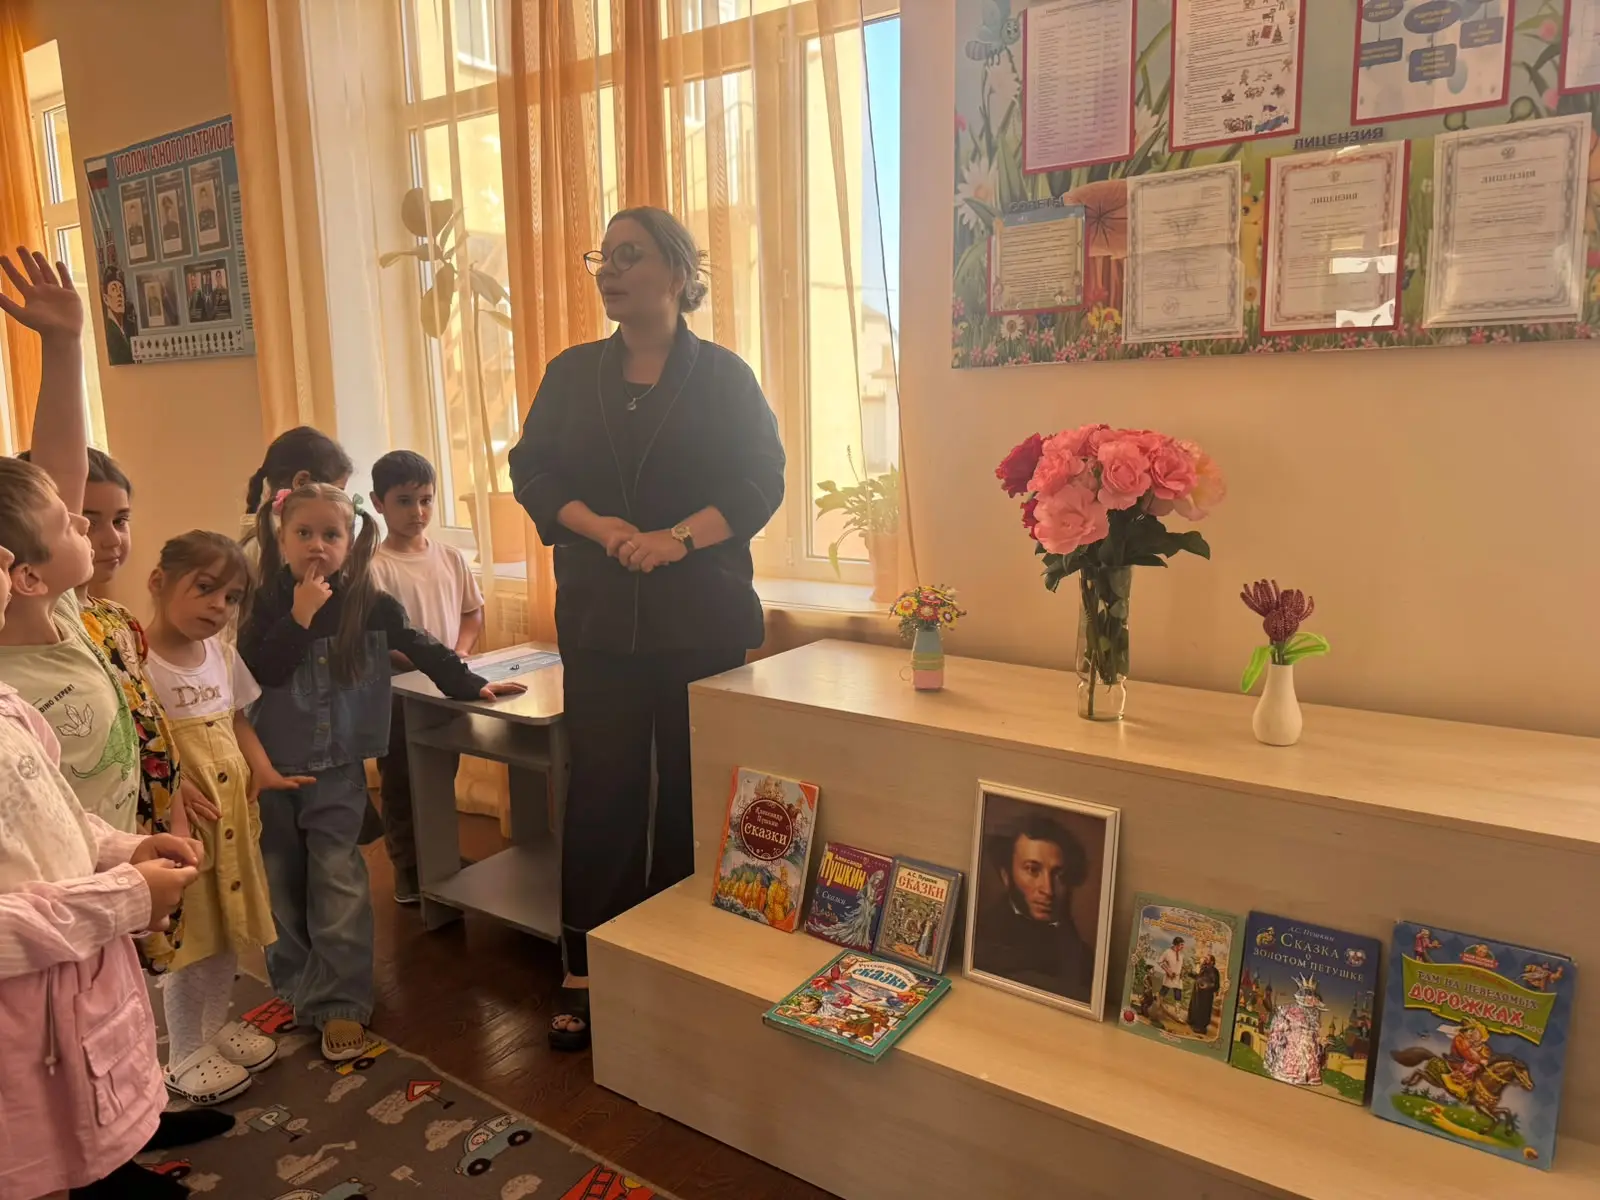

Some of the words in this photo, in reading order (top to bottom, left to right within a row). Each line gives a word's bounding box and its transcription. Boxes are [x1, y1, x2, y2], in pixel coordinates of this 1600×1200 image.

[1293, 127, 1384, 150] ЛИЦЕНЗИЯ
[114, 147, 150, 178] УГОЛОК
[150, 137, 183, 169] ЮНОГО
[38, 699, 55, 714] DINO
[171, 685, 222, 708] Dior
[820, 851, 867, 890] Пушкин
[898, 875, 945, 900] СКАЗКИ
[1253, 946, 1307, 968] ЗОЛОТОМ
[1310, 961, 1364, 982] ПЕТУШКЕ
